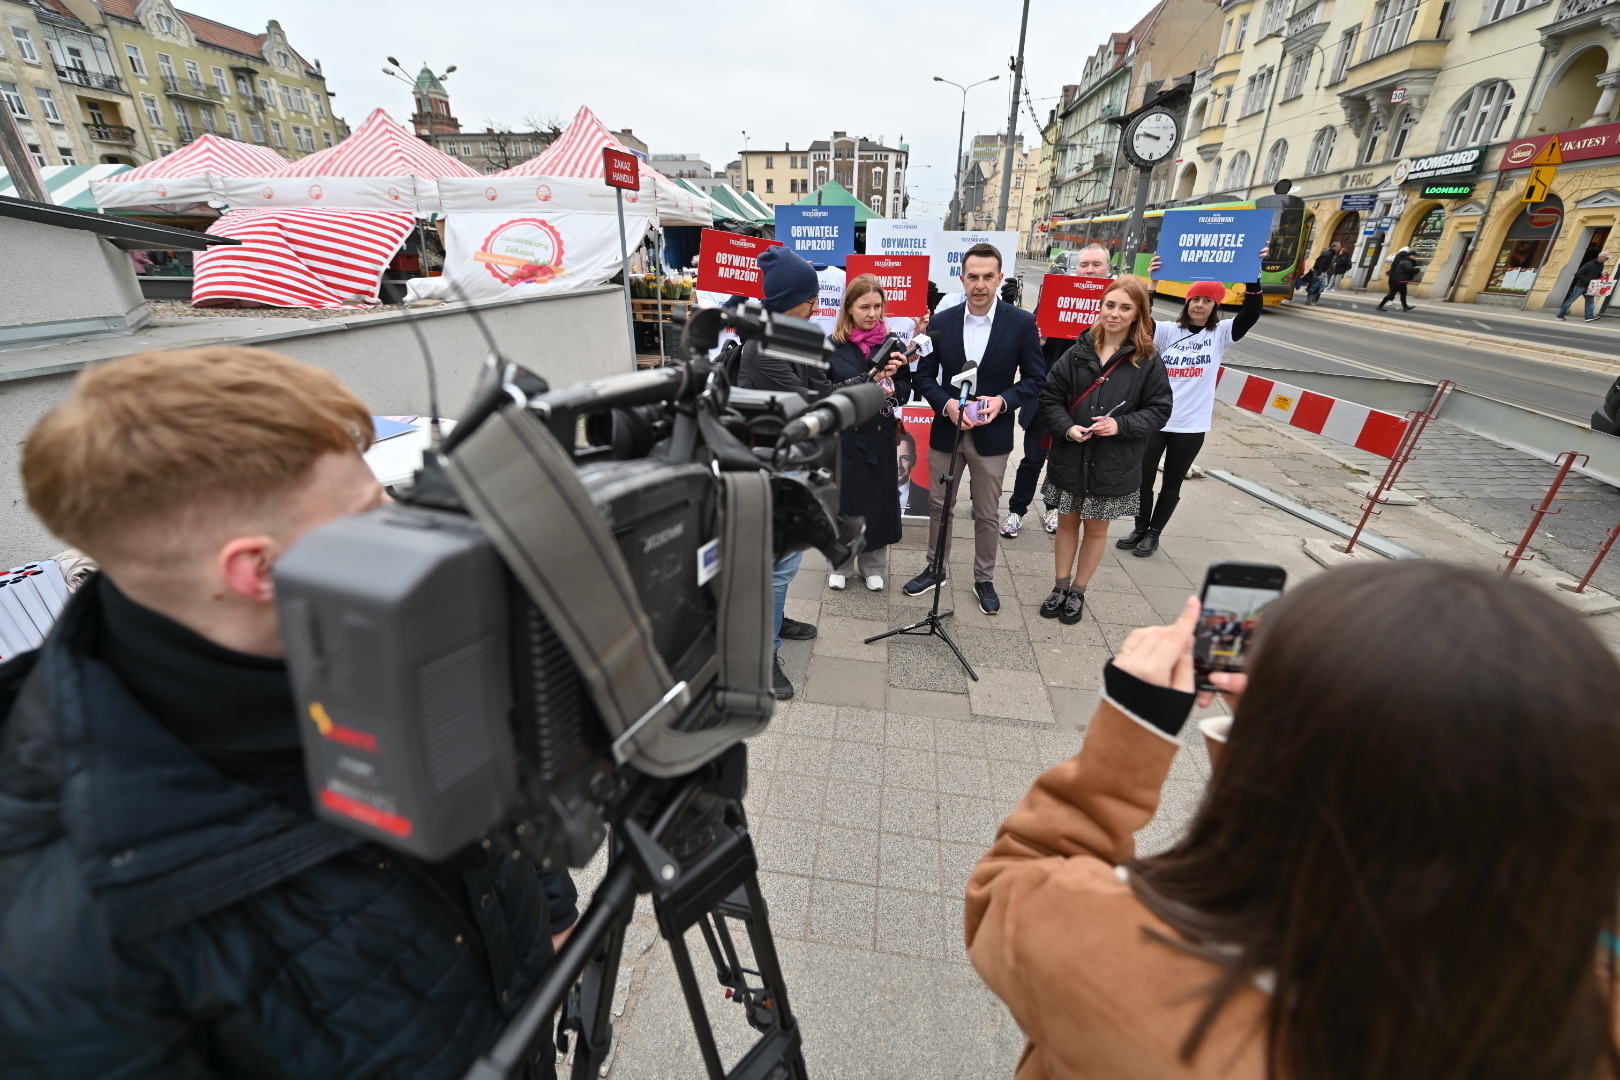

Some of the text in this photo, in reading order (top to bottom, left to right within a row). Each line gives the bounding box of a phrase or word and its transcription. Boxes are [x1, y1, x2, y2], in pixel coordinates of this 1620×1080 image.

[1393, 92, 1403, 100] 30
[1169, 133, 1174, 142] 3
[1560, 136, 1609, 152] LIKATESY
[1148, 152, 1154, 160] 6
[1409, 149, 1480, 173] LOOMBARD
[613, 158, 632, 172] ZAKAZ
[612, 171, 635, 185] HANDLU
[1349, 172, 1374, 187] FMG
[1425, 186, 1471, 194] LOOMBARD
[791, 225, 839, 238] OBYWATELE
[500, 234, 549, 251] Zaczarowany
[795, 237, 835, 251] NAPRZÓD!
[881, 237, 927, 249] OBYWATELE
[1178, 233, 1246, 248] OBYWATELE
[1180, 247, 1236, 263] NAPRZÓD!
[718, 266, 759, 283] NAPRZÓD!
[877, 275, 912, 288] WATELE
[884, 287, 907, 302] RZÓD!
[1057, 296, 1101, 312] OBYWATE
[1180, 354, 1212, 366] POLSKA
